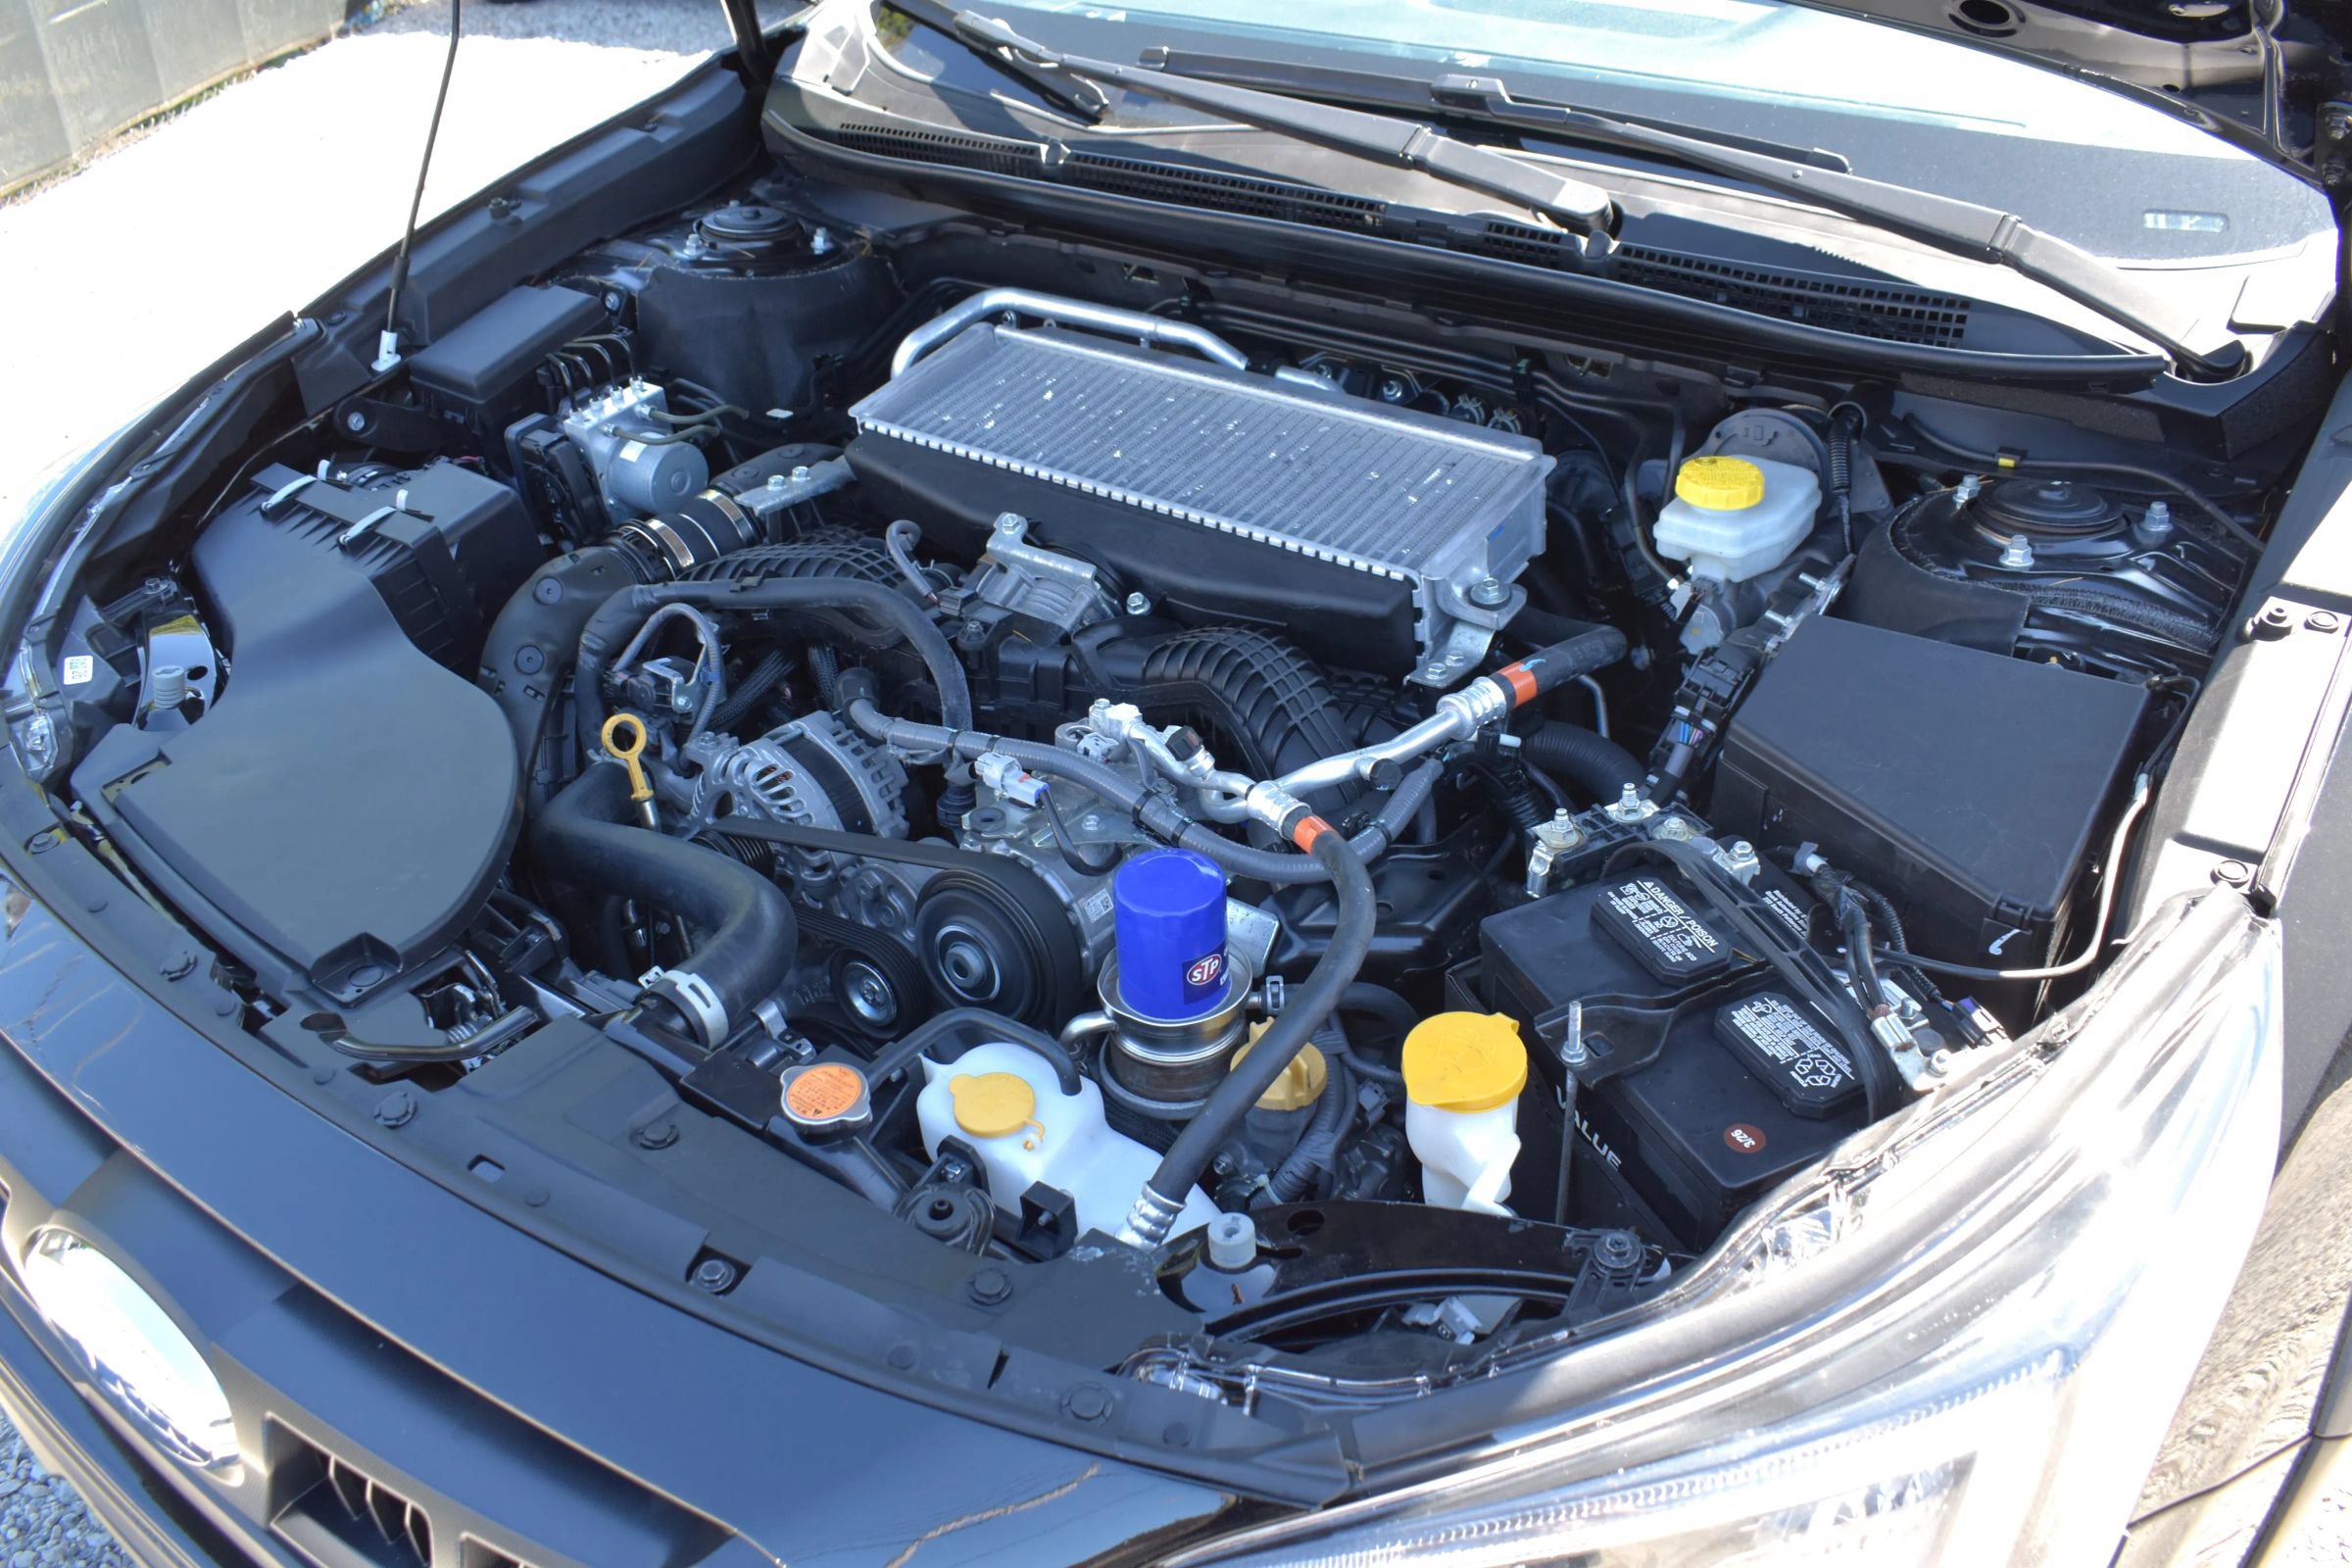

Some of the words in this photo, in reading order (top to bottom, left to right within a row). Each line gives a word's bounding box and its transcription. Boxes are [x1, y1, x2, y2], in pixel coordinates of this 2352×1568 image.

[1650, 885, 1685, 915] DANGER
[1685, 919, 1719, 948] POISON
[1191, 957, 1219, 982] STP
[1731, 1129, 1755, 1149] 3/26
